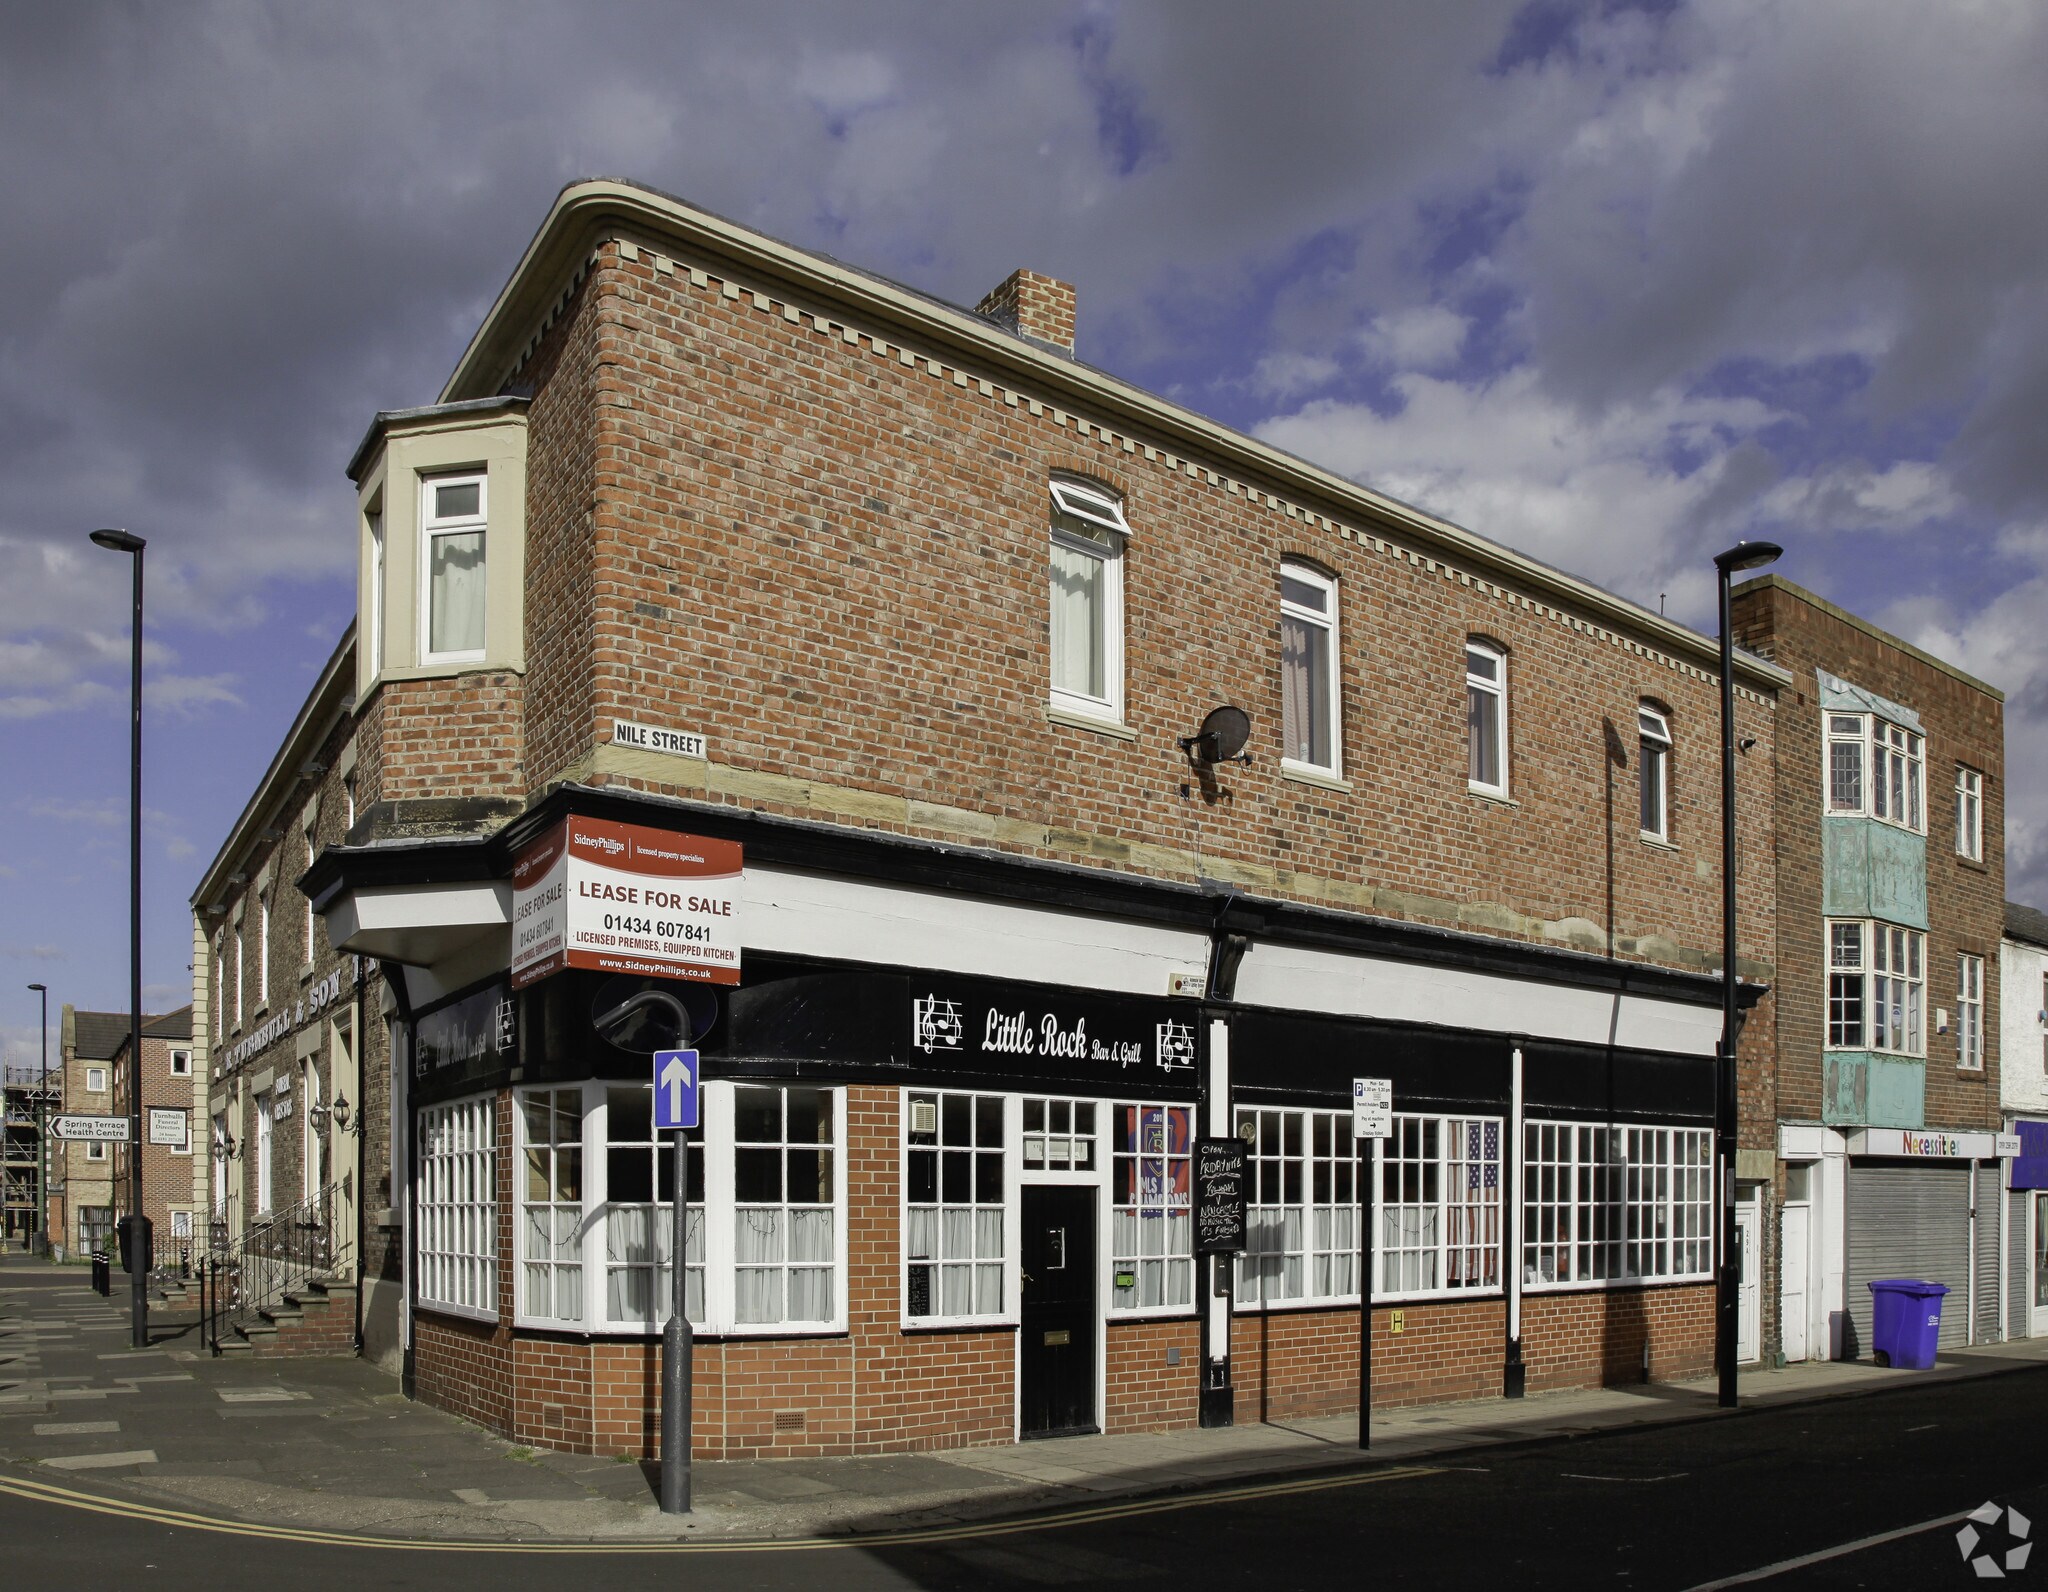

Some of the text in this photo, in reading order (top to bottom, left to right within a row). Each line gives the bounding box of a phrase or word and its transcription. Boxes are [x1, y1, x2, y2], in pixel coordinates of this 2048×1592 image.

[617, 724, 702, 754] NILE STREET
[574, 834, 625, 851] SidneyPhillips
[636, 846, 705, 864] licensed property specialists
[514, 883, 562, 922] LEASE FOR SALE
[580, 881, 732, 916] LEASE FOR SALE
[604, 914, 711, 942] 01434 607841
[576, 931, 735, 961] LICENSED PREMISES, EQUIPPED KITCHEN
[600, 958, 711, 978] www.SidneyPhillips.co.uk
[234, 1008, 290, 1065] TURNBULL
[295, 1000, 304, 1024] &
[309, 968, 341, 1015] SON
[982, 1008, 1142, 1068] Little Rock Bar & Grill
[1356, 1084, 1362, 1095] P
[65, 1120, 92, 1128] Spring
[1903, 1132, 1960, 1155] Necessities
[1200, 1202, 1239, 1216] NEWCASTLE
[1394, 1313, 1402, 1330] H
